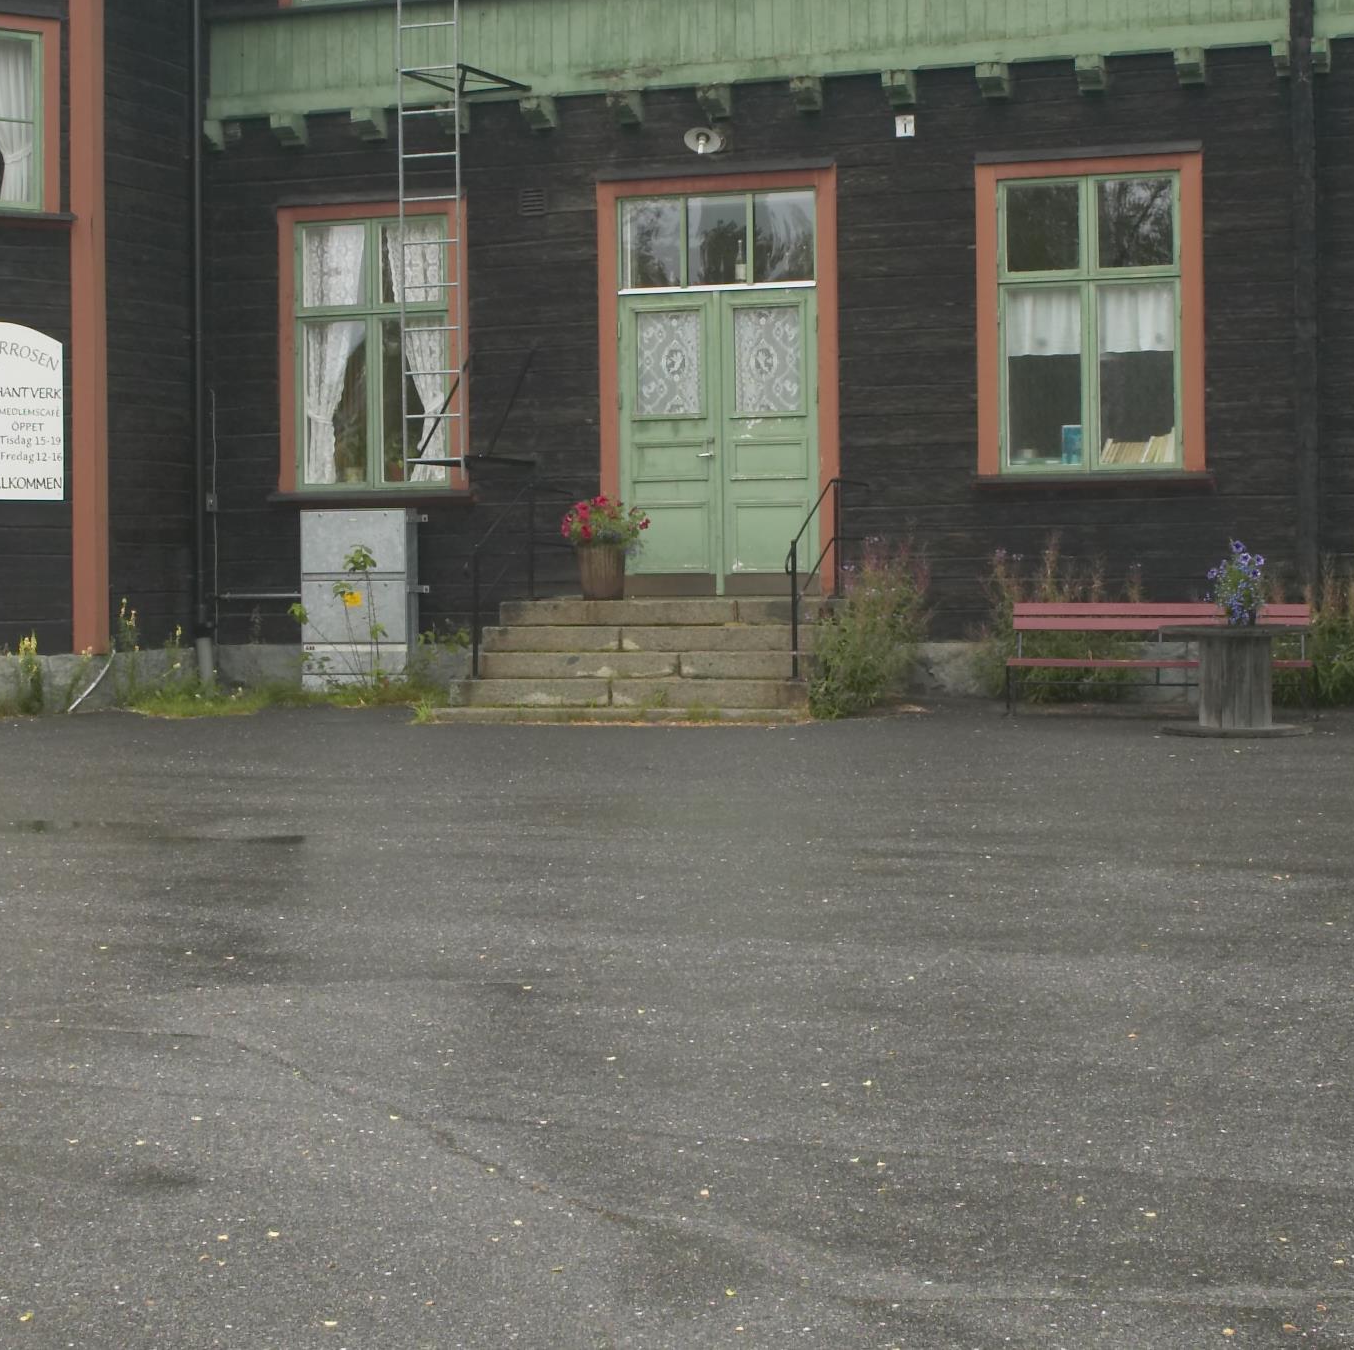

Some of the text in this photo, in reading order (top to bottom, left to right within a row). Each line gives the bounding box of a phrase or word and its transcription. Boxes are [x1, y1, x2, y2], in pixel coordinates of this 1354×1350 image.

[11, 420, 45, 432] ÖPPET
[0, 435, 32, 448] Tisdag
[0, 451, 35, 464] Fredag
